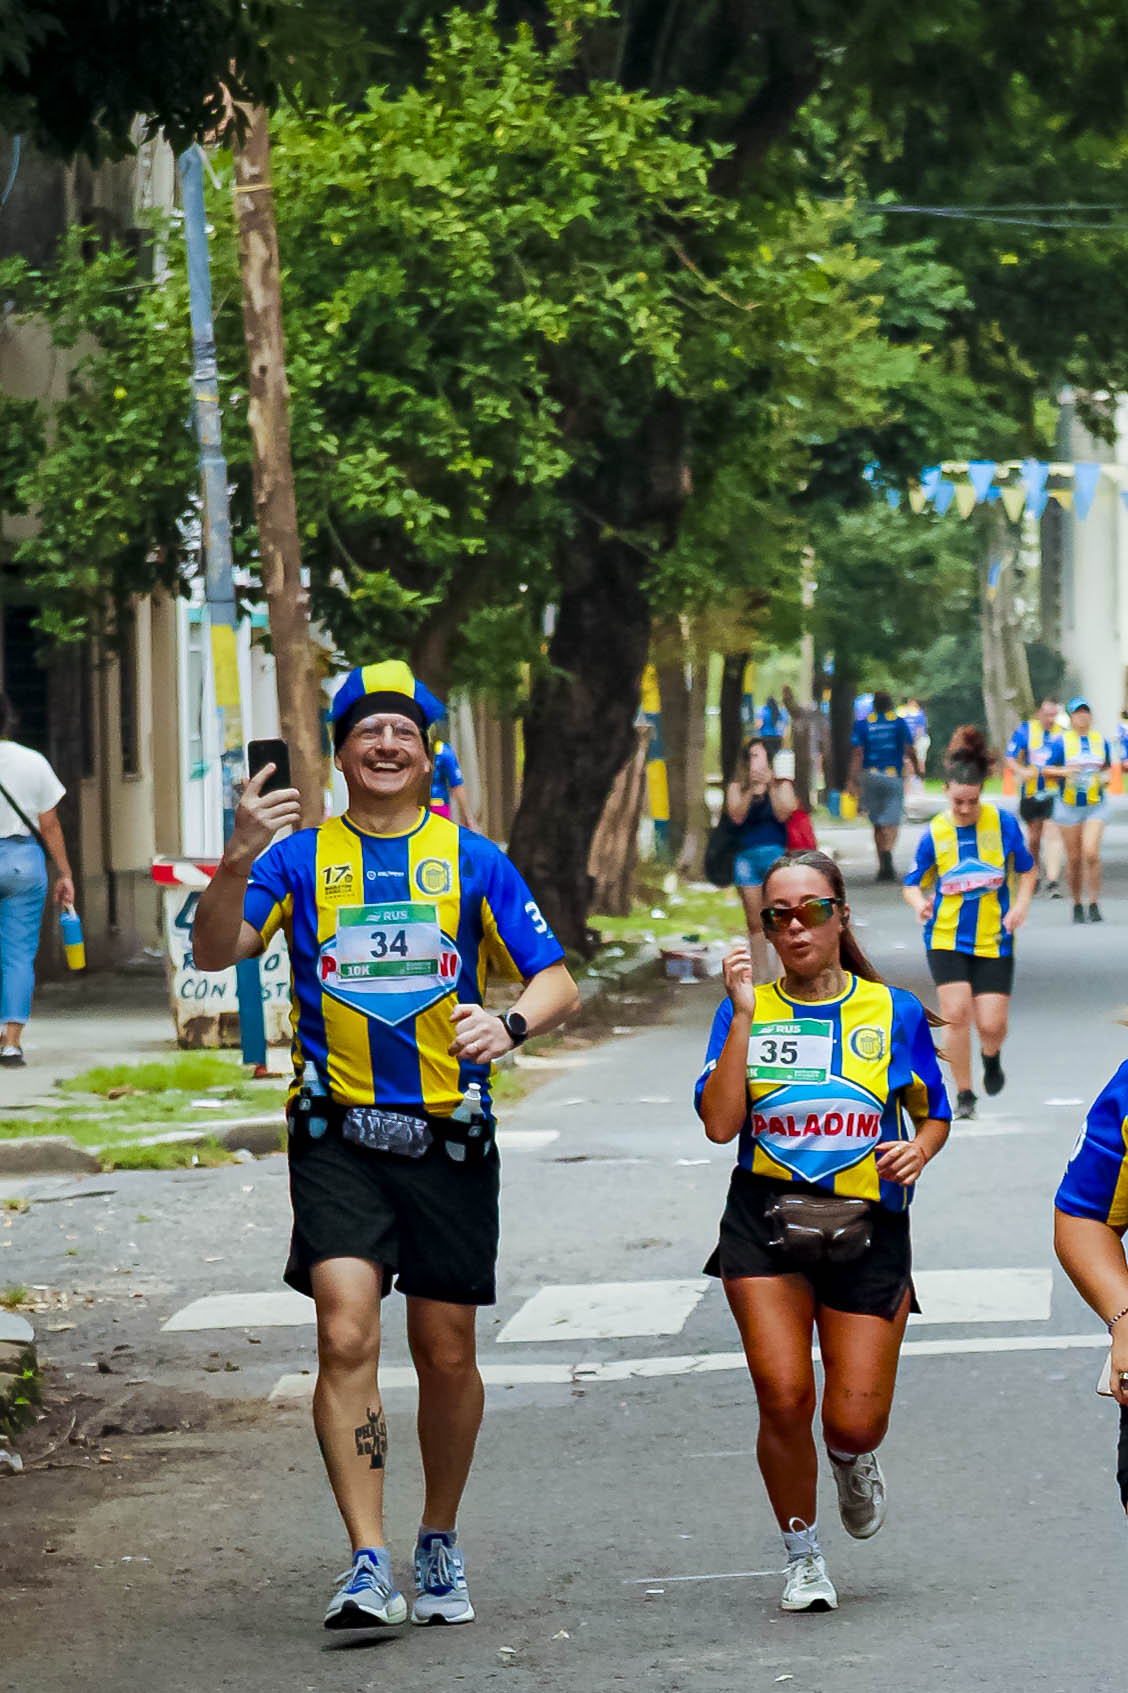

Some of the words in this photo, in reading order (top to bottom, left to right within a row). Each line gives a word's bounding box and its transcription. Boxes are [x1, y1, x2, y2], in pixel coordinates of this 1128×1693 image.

[383, 910, 408, 921] RUS
[369, 929, 408, 959] 34
[775, 1024, 801, 1034] RUS
[759, 1039, 798, 1065] 35
[753, 1111, 881, 1138] PALADINI
